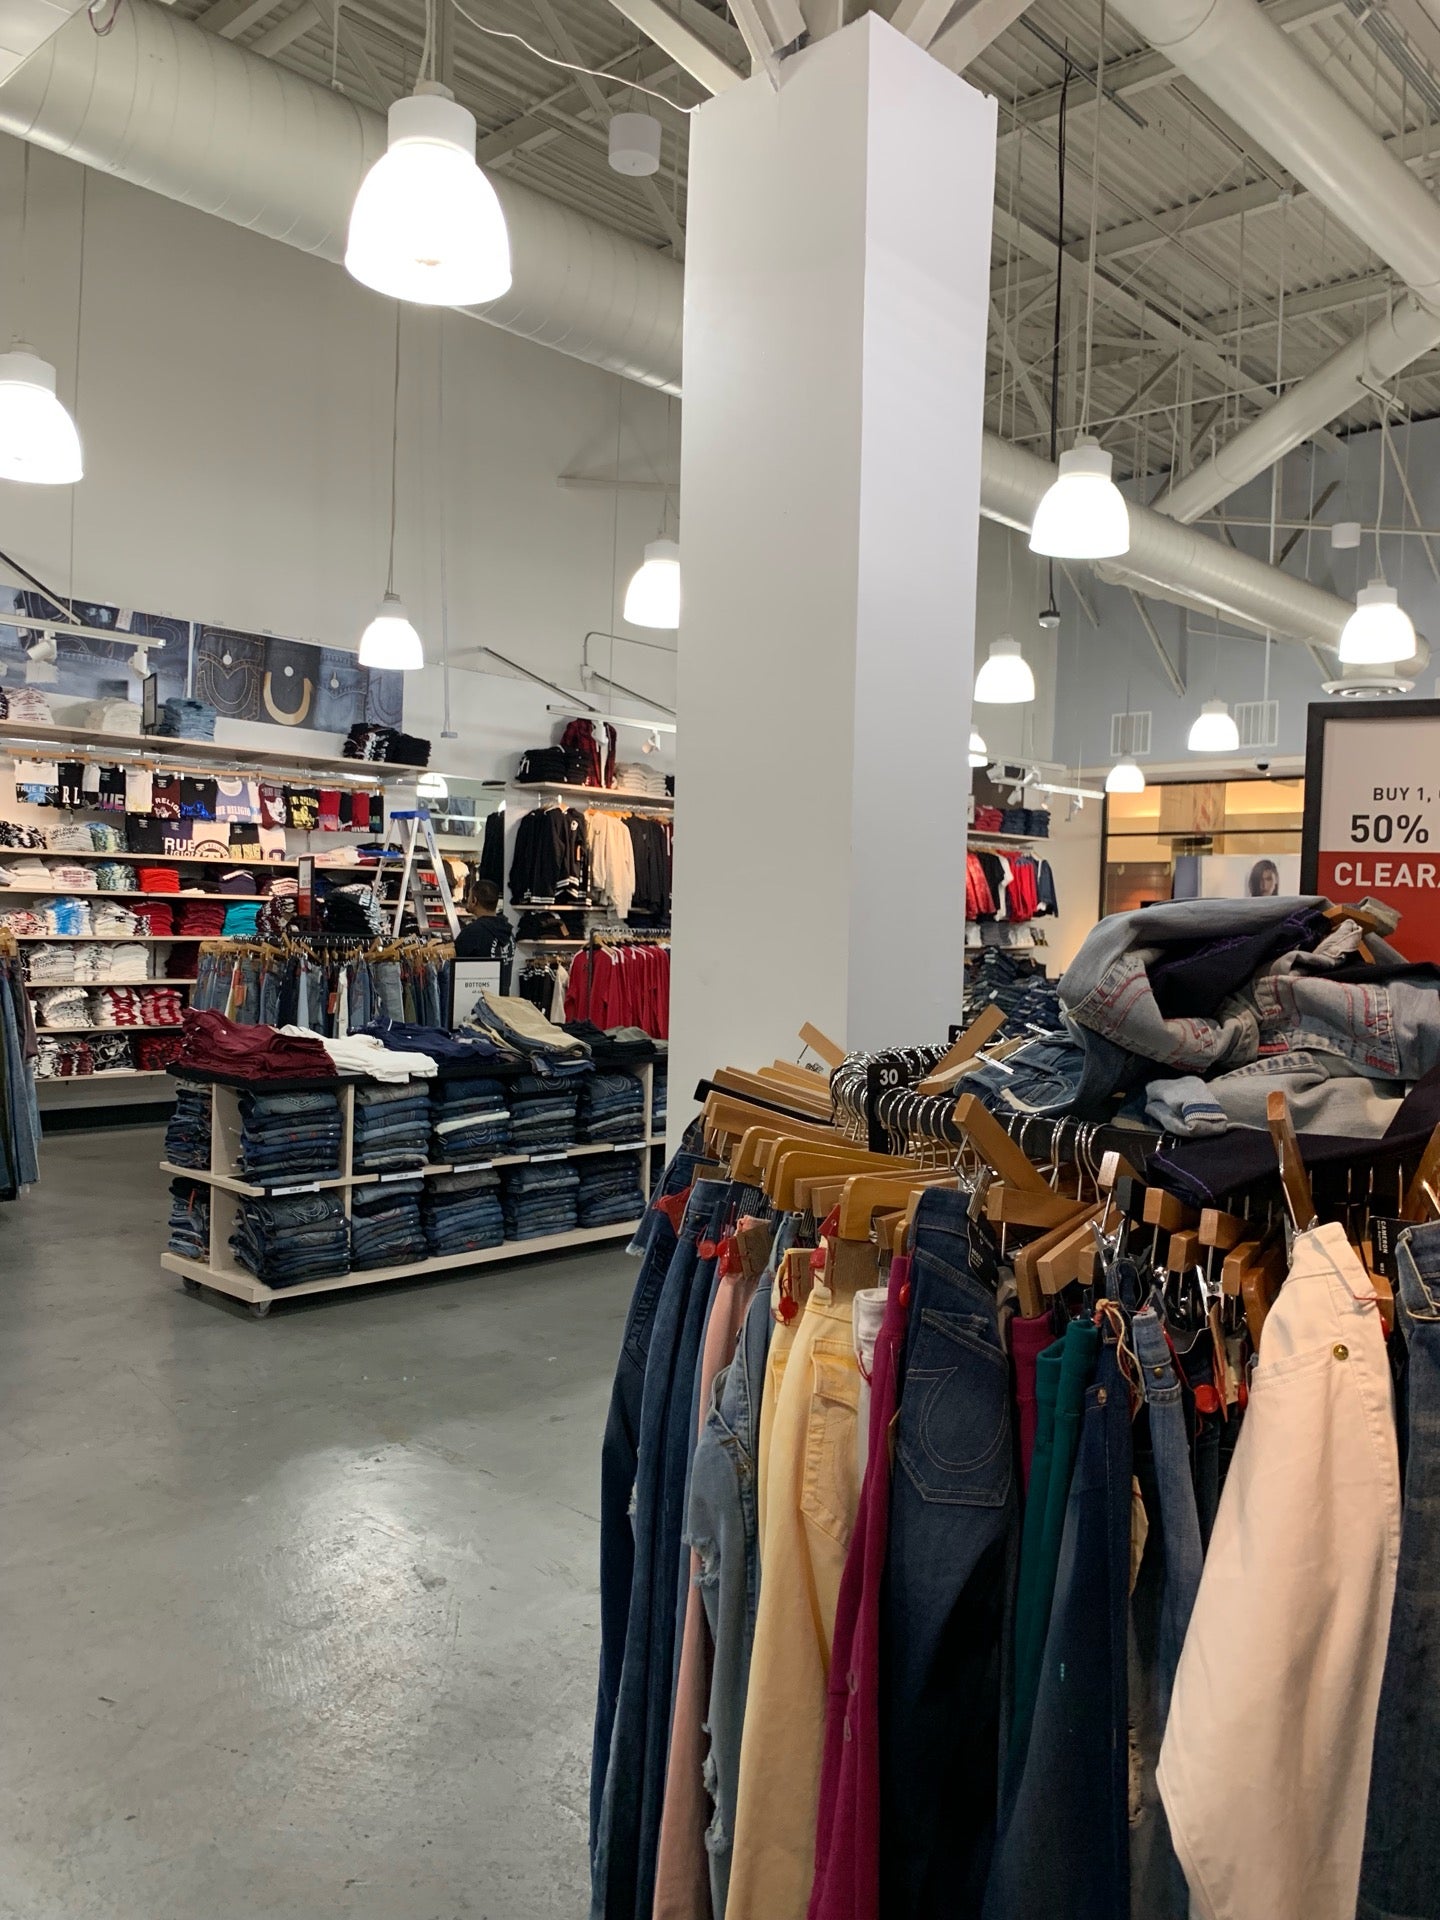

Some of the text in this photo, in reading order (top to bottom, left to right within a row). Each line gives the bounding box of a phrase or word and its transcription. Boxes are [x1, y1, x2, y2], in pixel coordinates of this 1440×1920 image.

[16, 785, 37, 793] TRUE
[1373, 787, 1431, 803] BUY 1,
[1350, 814, 1429, 843] 50%
[164, 837, 195, 851] RUE
[1334, 862, 1440, 888] CLEAR
[880, 1068, 899, 1086] 30
[1381, 1220, 1389, 1254] CAMERON
